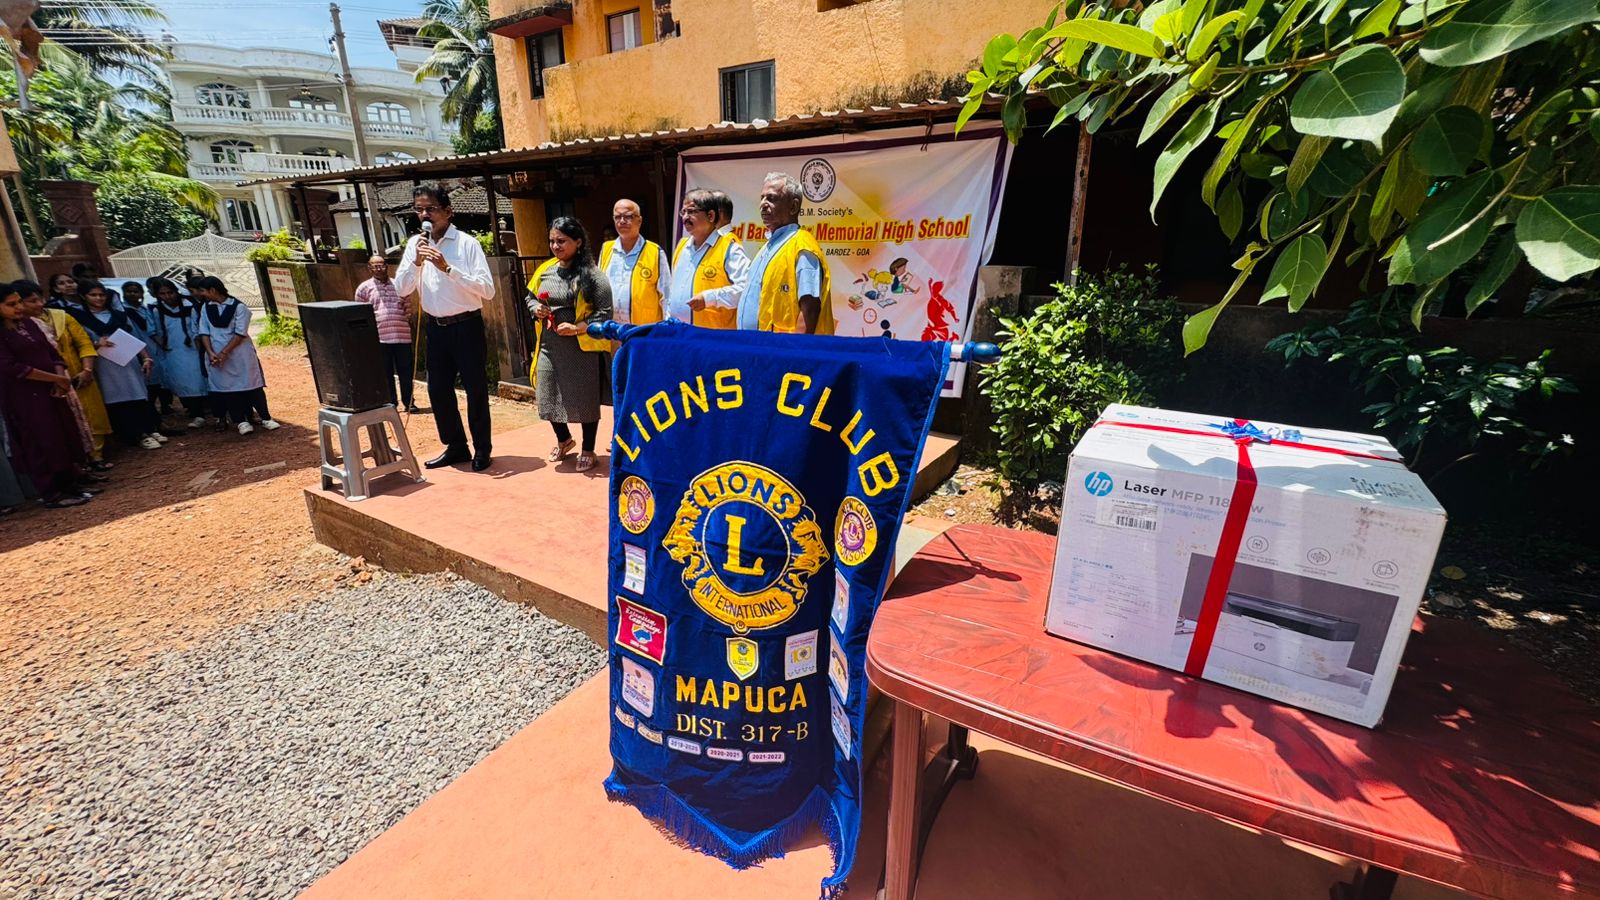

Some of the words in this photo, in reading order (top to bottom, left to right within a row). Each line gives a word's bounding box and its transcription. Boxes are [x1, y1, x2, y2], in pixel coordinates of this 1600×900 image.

[817, 207, 853, 218] Society's
[815, 221, 879, 241] Memorial
[881, 219, 914, 244] High
[918, 215, 970, 239] School
[825, 248, 851, 256] BARDEZ
[856, 247, 871, 256] GOA
[614, 368, 744, 462] LIONS
[776, 372, 900, 496] CLUB
[636, 479, 652, 500] CLUB
[700, 471, 795, 515] LIONS
[1086, 471, 1112, 496] hp
[1124, 480, 1168, 496] Laser
[1172, 489, 1204, 503] MFP
[1209, 495, 1264, 514] 118w
[621, 511, 651, 532] SPONSOR
[855, 503, 874, 531] CLUB
[723, 514, 766, 576] L
[837, 532, 867, 562] SPONSOR
[699, 581, 787, 619] INTERNATIONAL
[676, 674, 808, 713] MAPUCA
[676, 713, 728, 740] DIST.
[709, 749, 741, 760] 2020-2021
[751, 753, 783, 761] 2021-2022
